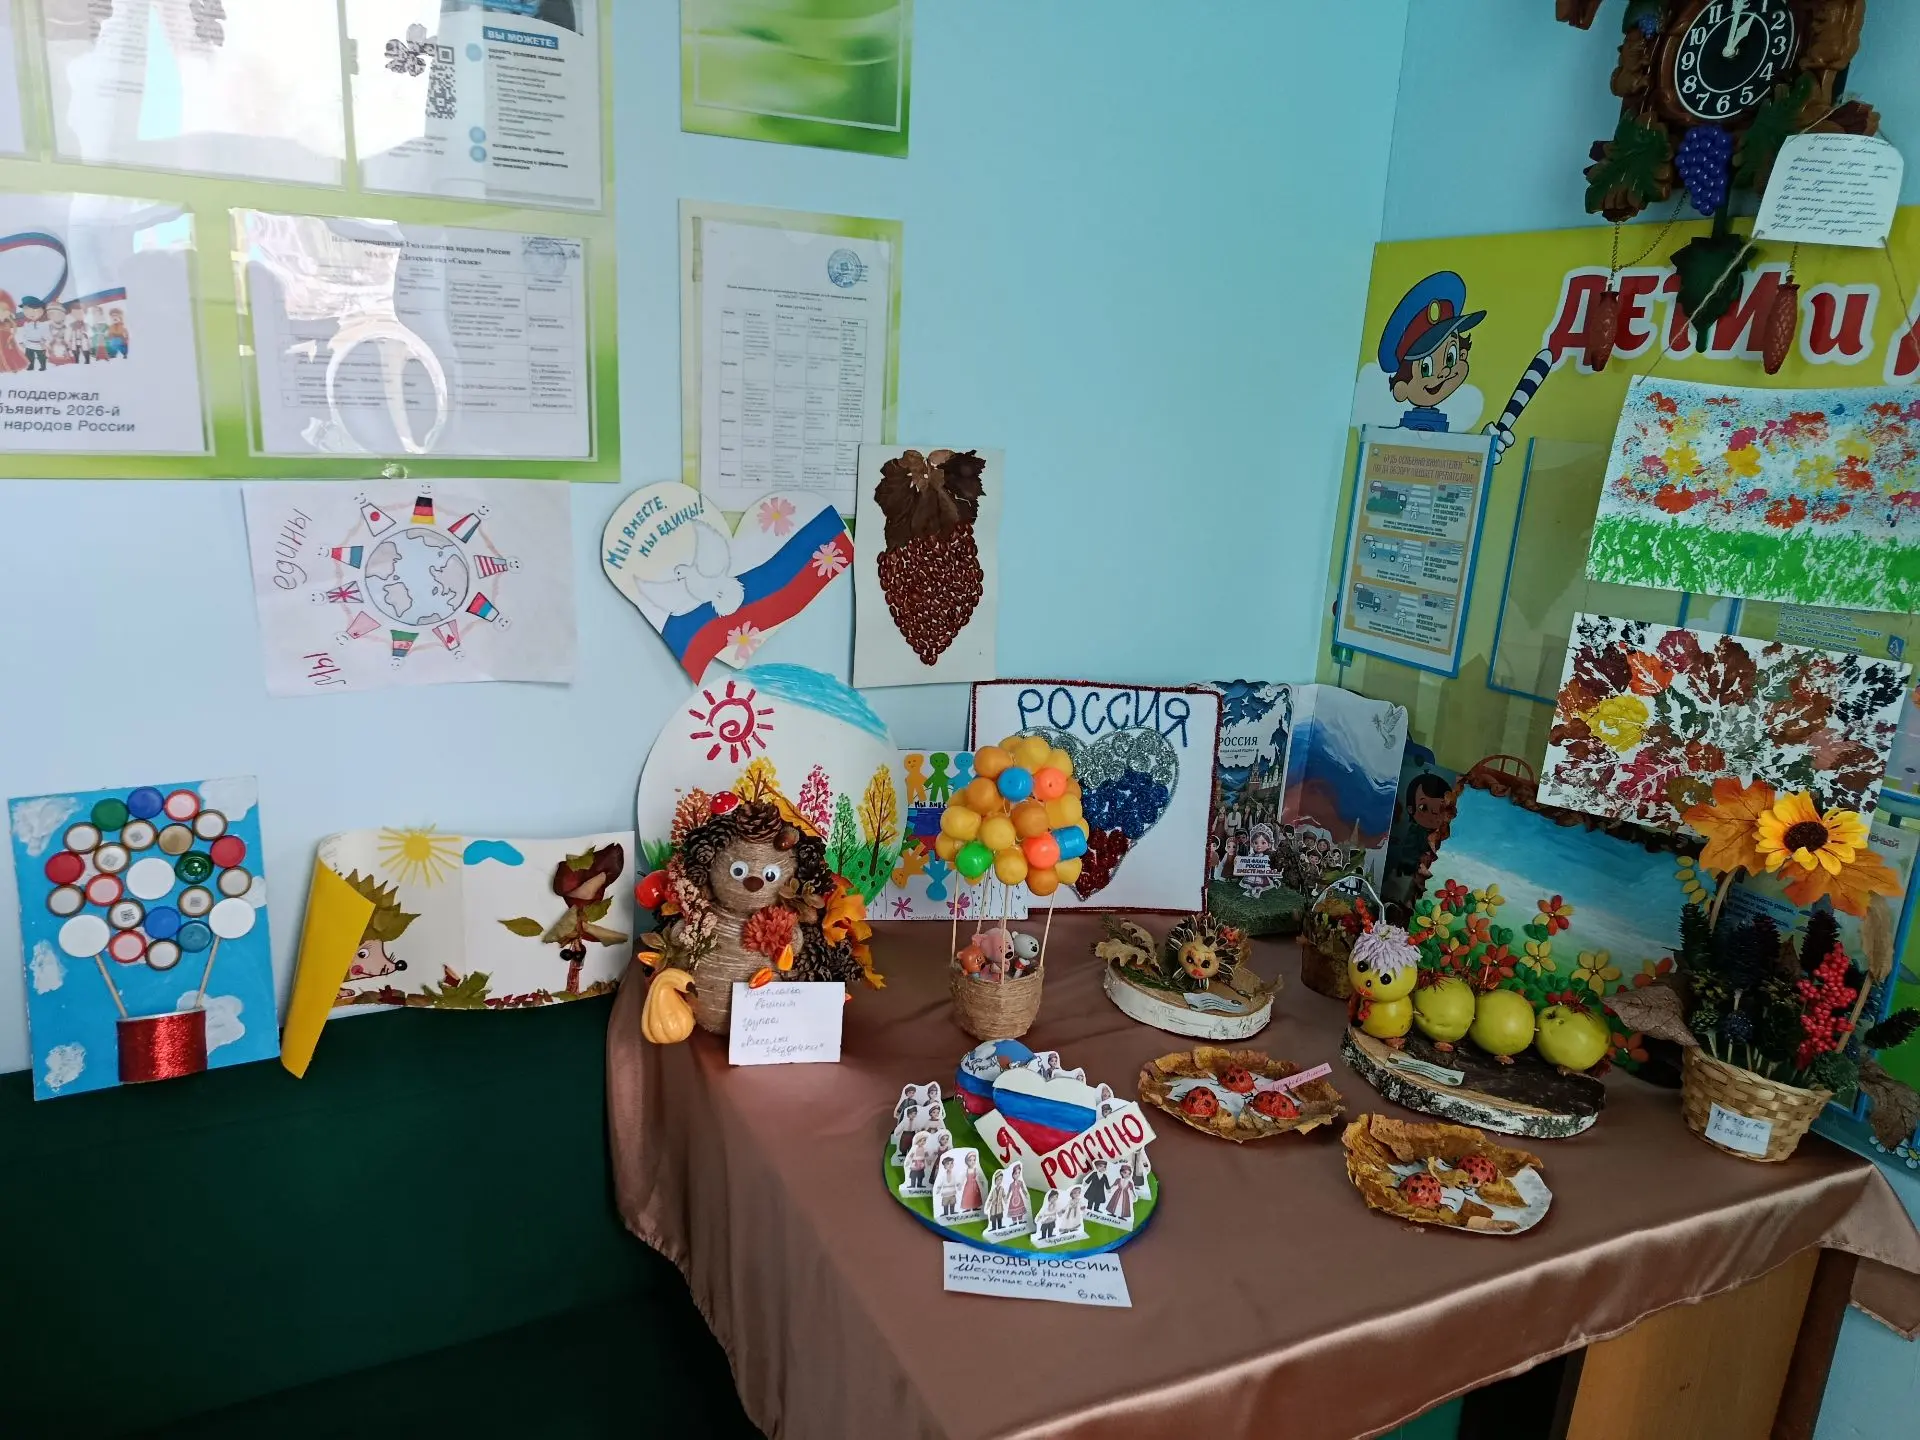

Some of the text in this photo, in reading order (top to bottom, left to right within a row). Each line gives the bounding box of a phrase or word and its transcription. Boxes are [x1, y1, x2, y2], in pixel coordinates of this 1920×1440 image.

[1708, 3, 1724, 25] 11
[1770, 10, 1786, 31] 2
[488, 29, 505, 40] ВЫ
[1689, 27, 1707, 46] 10
[1771, 36, 1787, 55] 3
[1681, 52, 1695, 71] 9
[1759, 62, 1775, 81] 4
[1682, 75, 1698, 94] 8
[1695, 92, 1711, 111] 7
[1716, 95, 1731, 114] 6
[1740, 86, 1754, 105] 5
[8, 389, 99, 402] поддержал
[66, 404, 120, 417] 2026-й
[4, 420, 135, 432] народов России
[1017, 687, 1190, 748] РОССИЯ
[996, 1113, 1145, 1190] Я РОССИЮ
[949, 1253, 1031, 1268] «НАРОДЫ
[1043, 1268, 1087, 1280] Никита
